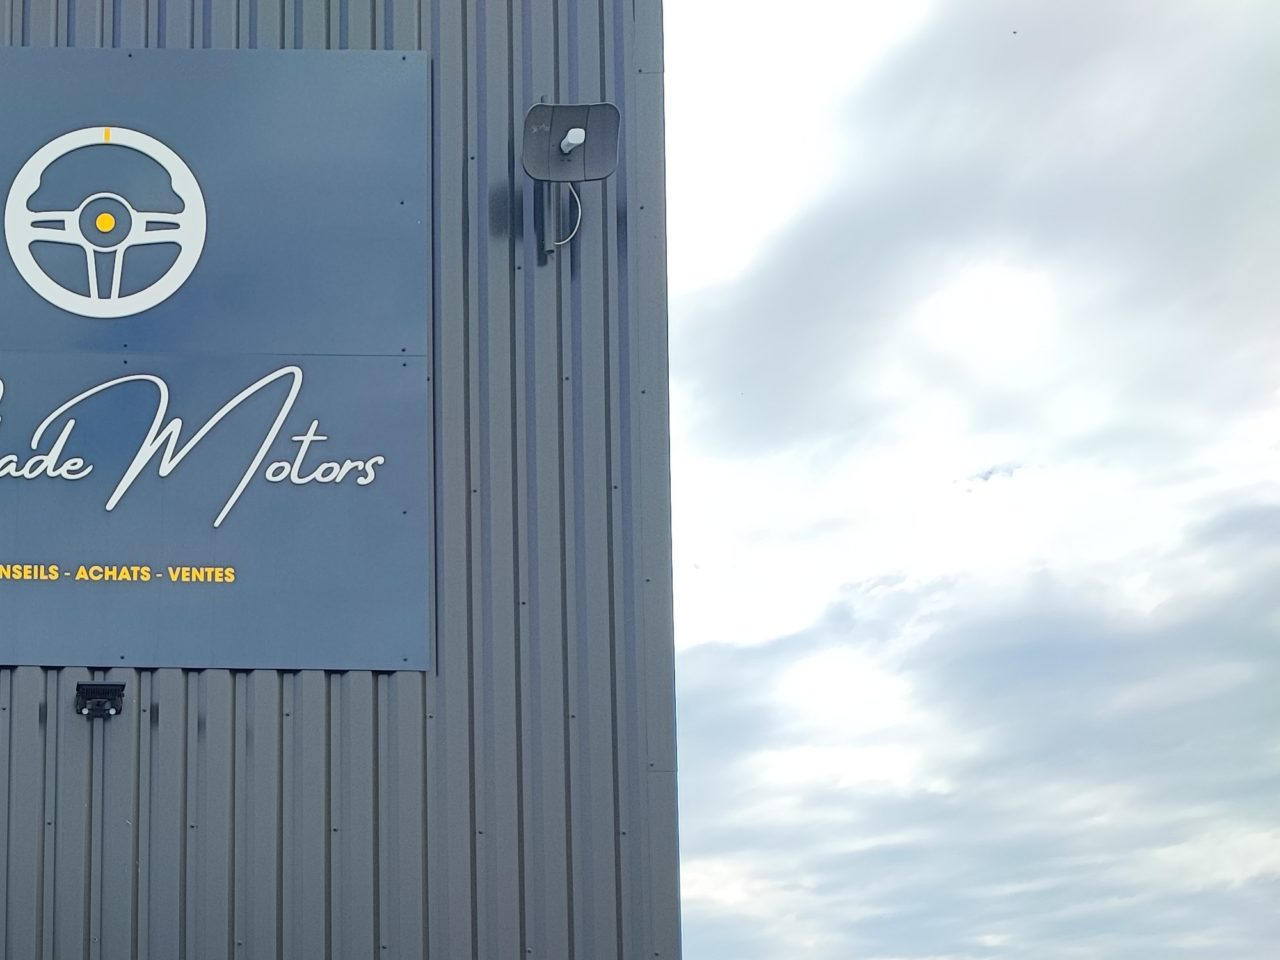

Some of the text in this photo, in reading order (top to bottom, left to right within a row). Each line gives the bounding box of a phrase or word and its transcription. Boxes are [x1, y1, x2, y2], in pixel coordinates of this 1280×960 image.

[32, 365, 385, 528] Motors
[75, 565, 151, 582] ACHATS
[168, 566, 236, 584] VENTES
